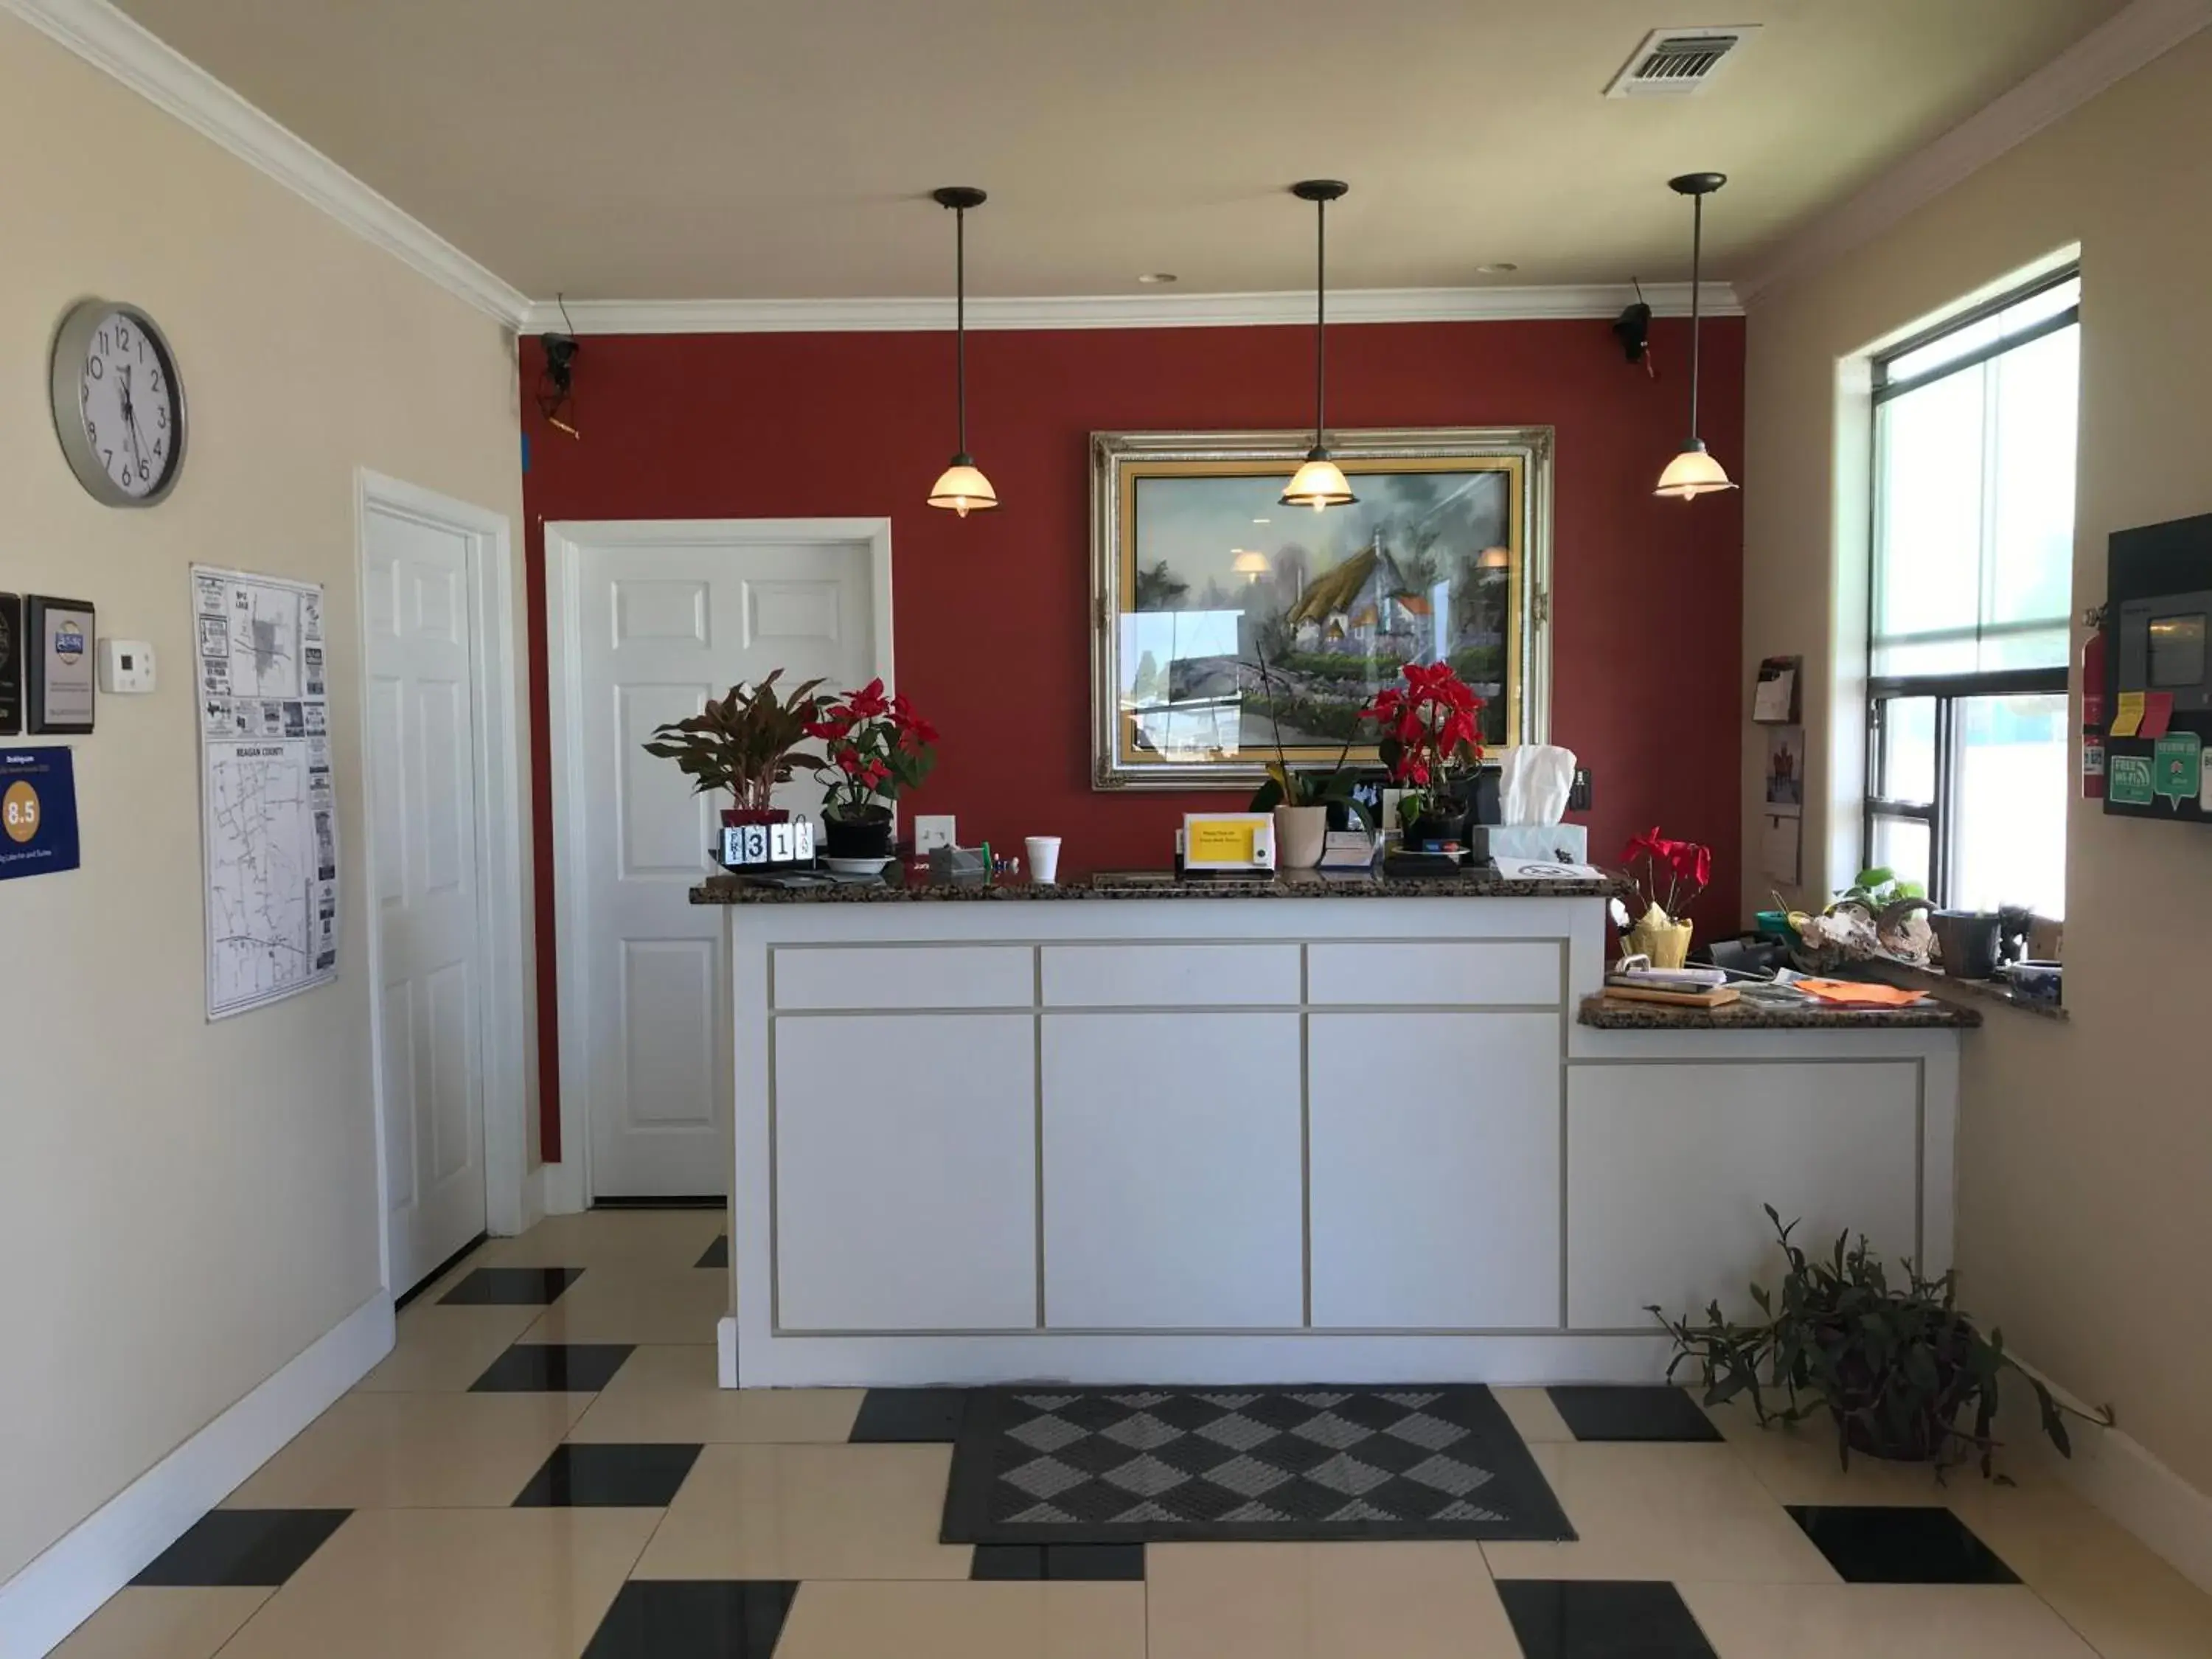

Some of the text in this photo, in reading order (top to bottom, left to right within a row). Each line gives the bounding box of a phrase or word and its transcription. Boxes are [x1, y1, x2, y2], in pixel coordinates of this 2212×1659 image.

[98, 330, 110, 356] 11
[115, 325, 130, 352] 12
[137, 341, 144, 365] 1
[86, 355, 103, 380] 10
[150, 369, 159, 392] 2
[157, 407, 167, 430] 3
[87, 422, 97, 443] 8
[103, 448, 114, 472] 7
[153, 437, 161, 459] 4
[122, 462, 131, 487] 6
[236, 746, 284, 757] REAGAN COUNTY
[8, 800, 35, 825] 8.5
[748, 833, 763, 858] 3
